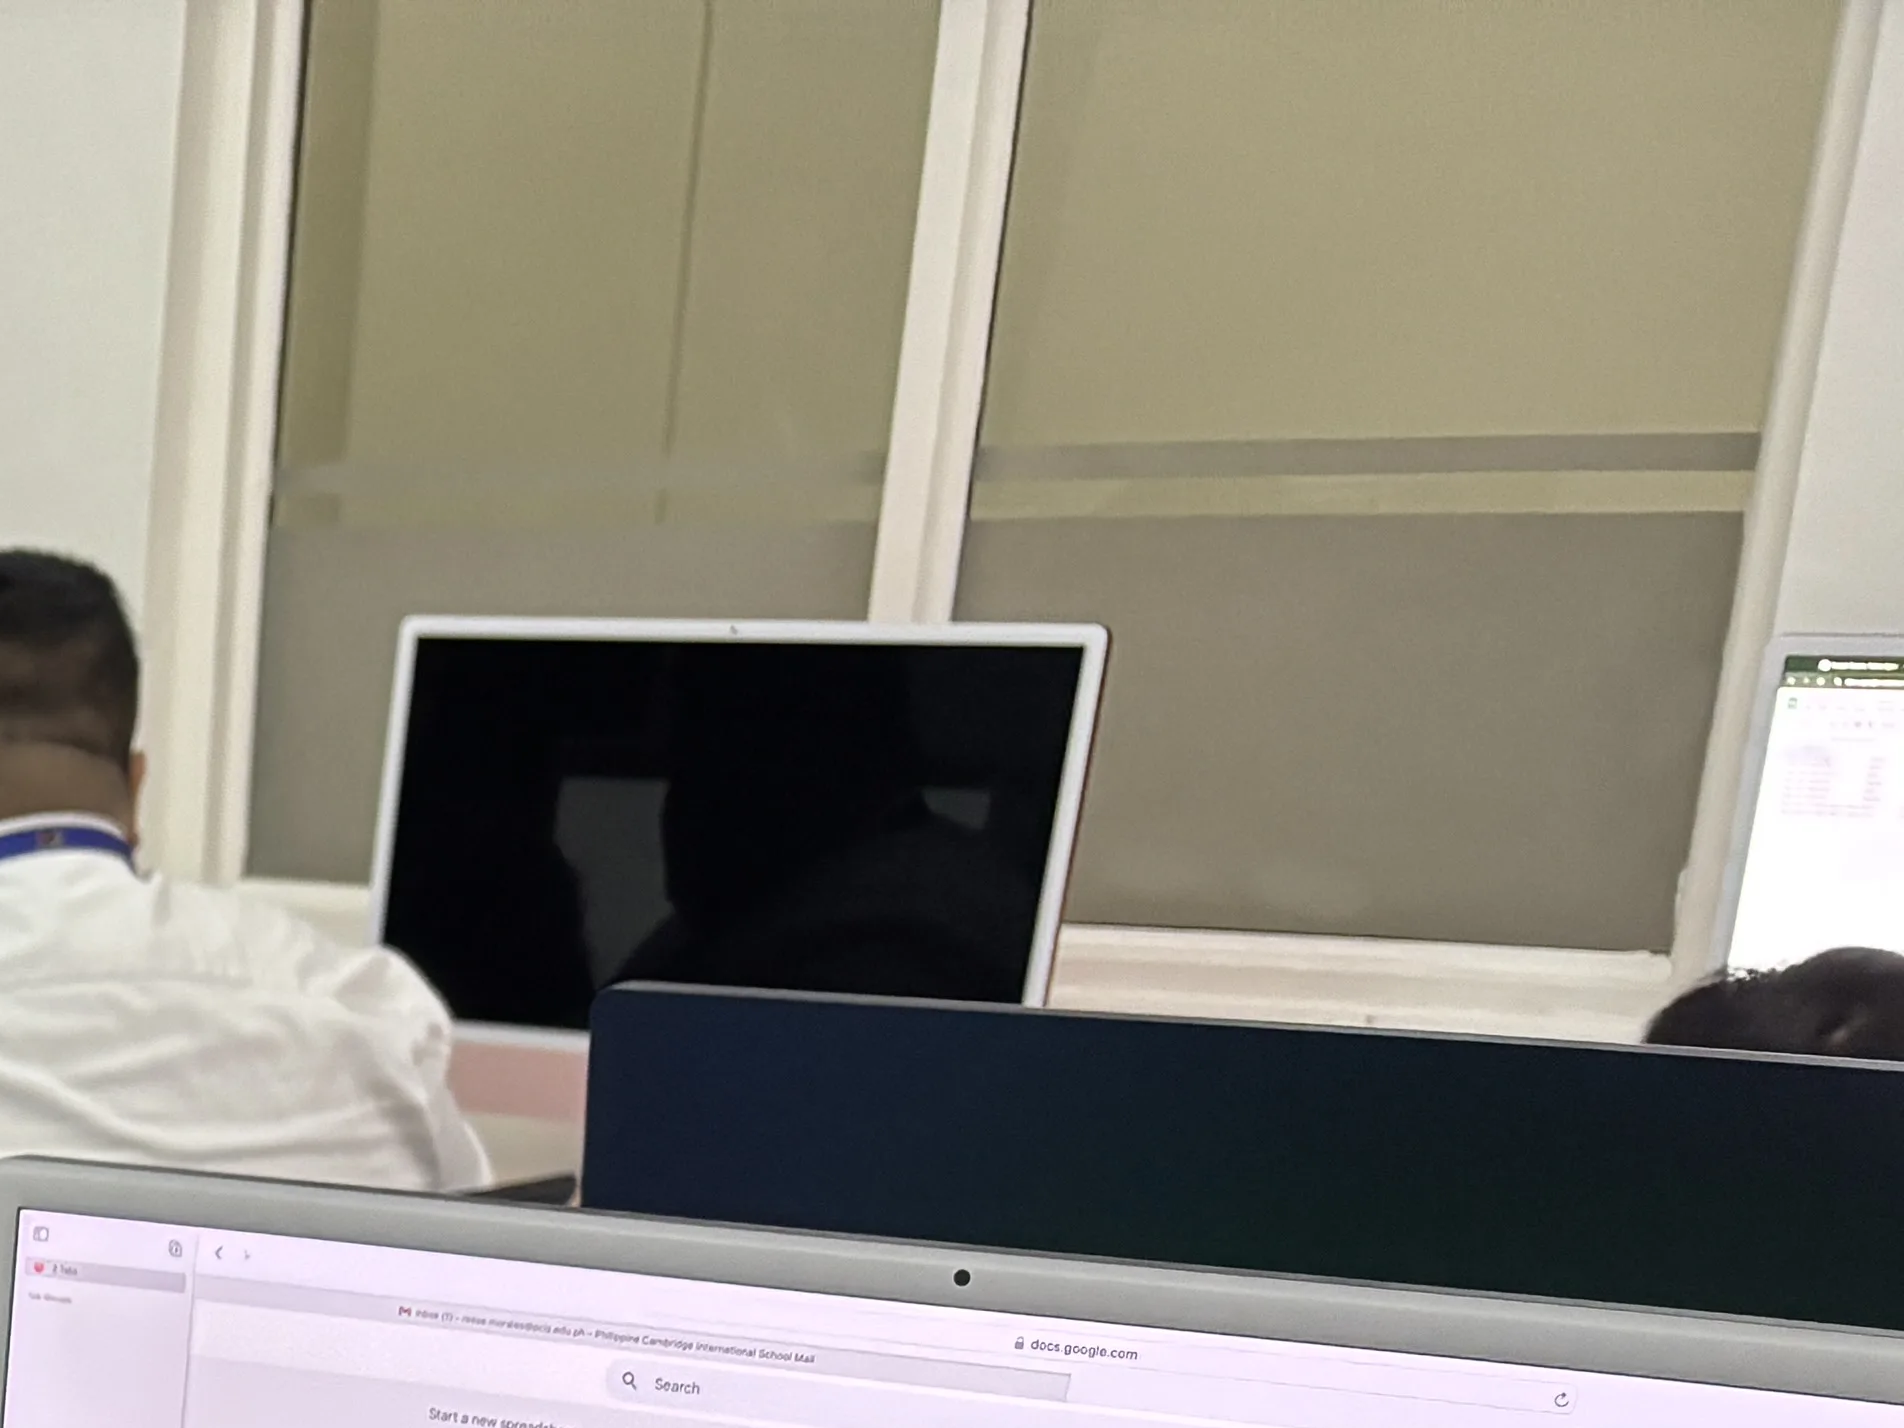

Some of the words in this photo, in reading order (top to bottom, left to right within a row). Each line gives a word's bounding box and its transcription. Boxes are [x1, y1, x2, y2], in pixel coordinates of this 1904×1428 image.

[641, 1335, 694, 1352] Cambridge
[758, 1348, 793, 1362] School
[1030, 1339, 1138, 1361] docs.google.com
[654, 1377, 701, 1395] Search
[428, 1407, 459, 1424] Start
[460, 1414, 470, 1425] a
[471, 1415, 498, 1428] new
